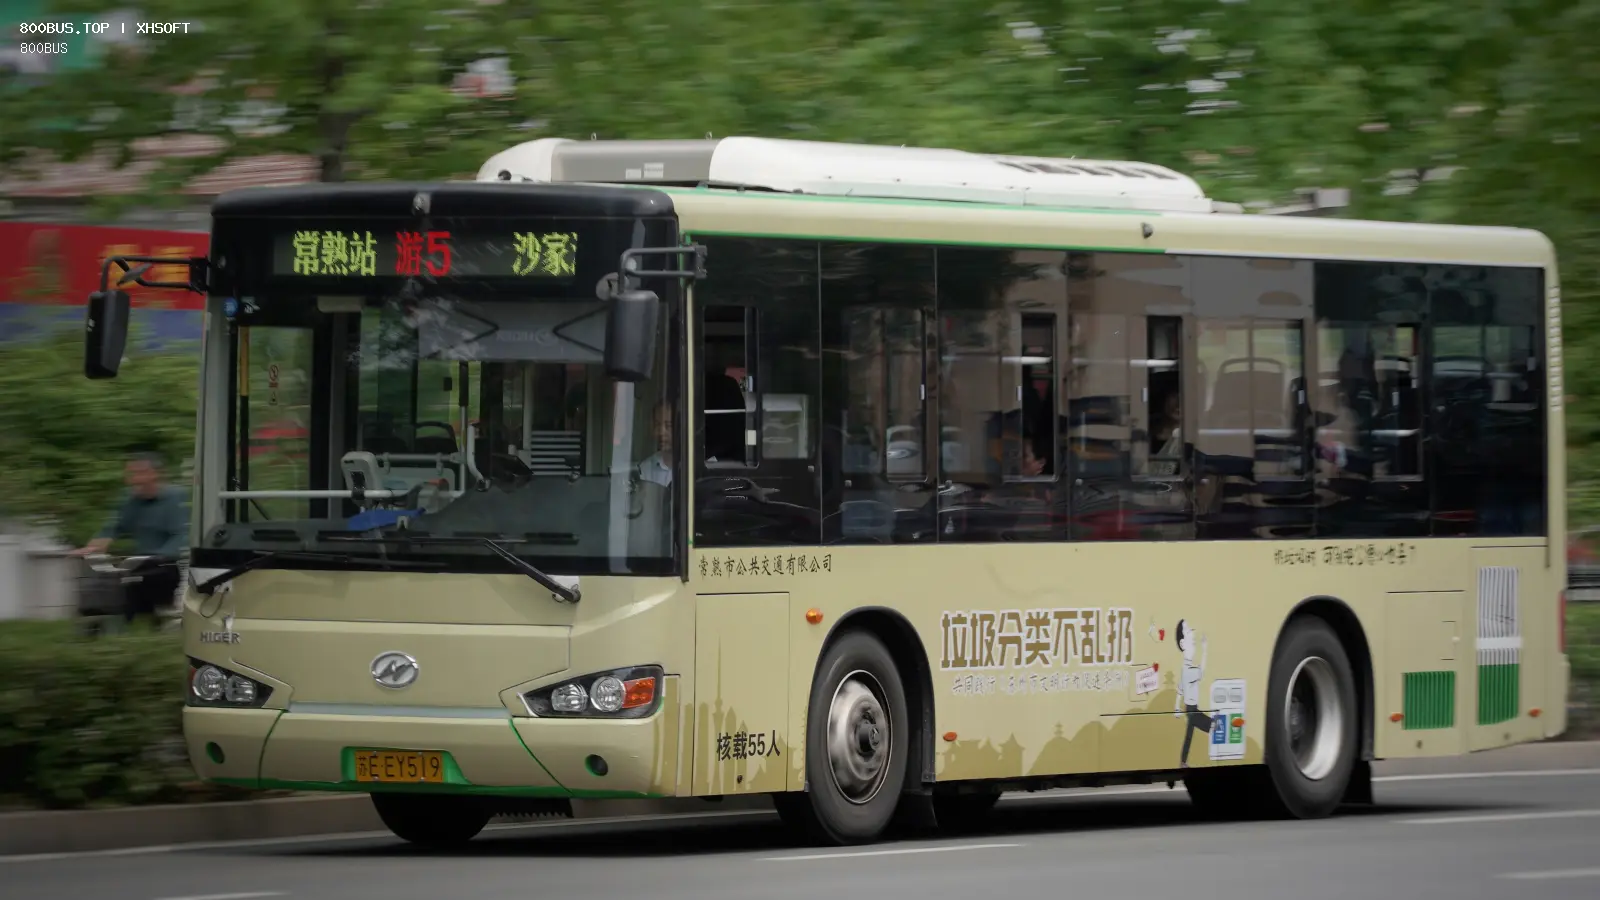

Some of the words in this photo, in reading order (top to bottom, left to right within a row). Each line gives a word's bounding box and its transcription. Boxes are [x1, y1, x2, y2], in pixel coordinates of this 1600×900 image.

[292, 230, 377, 276] 常熟站
[395, 231, 450, 276] 游5
[511, 231, 578, 276] 沙家
[698, 553, 833, 580] 常熟市公共交通有限公司
[200, 631, 240, 645] HIGER
[940, 607, 1135, 671] 垃圾分类不乱扔
[716, 729, 781, 761] 核载55人
